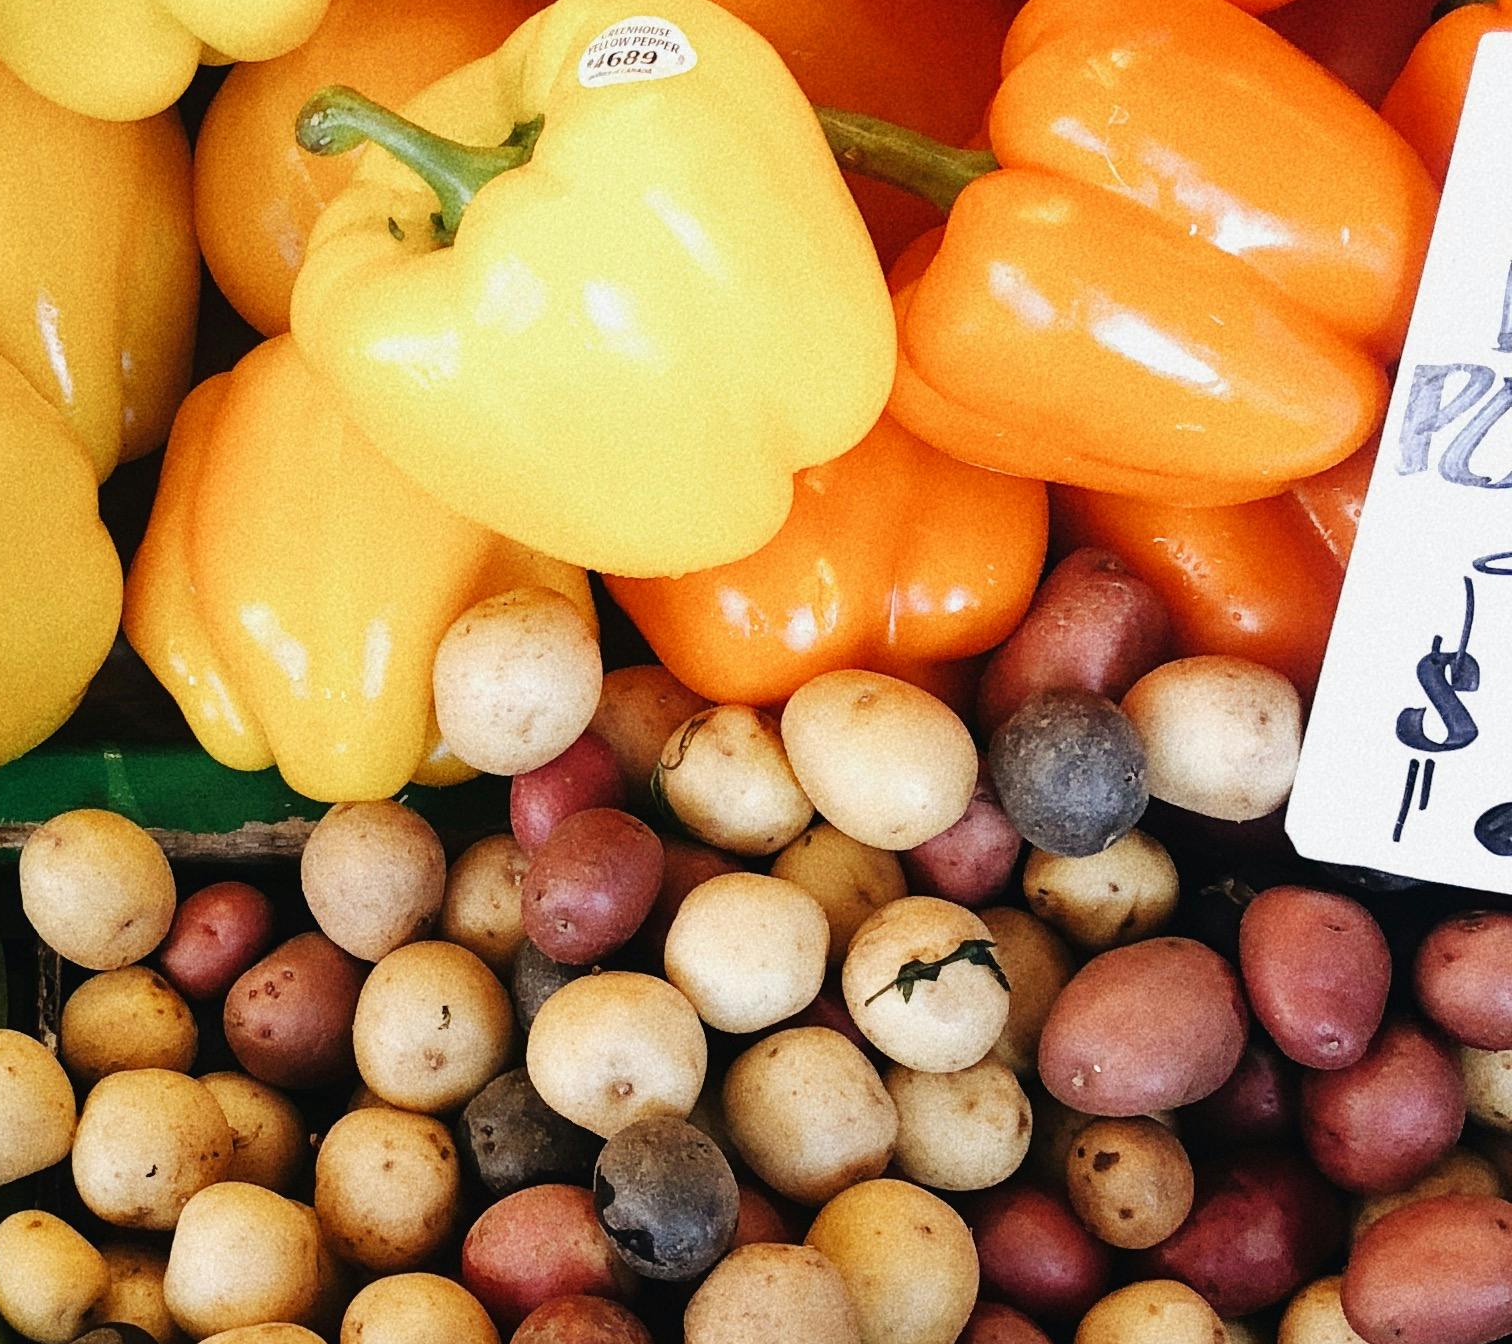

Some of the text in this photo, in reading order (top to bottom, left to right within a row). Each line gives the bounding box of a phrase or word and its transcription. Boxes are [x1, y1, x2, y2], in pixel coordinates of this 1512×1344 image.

[601, 25, 672, 39] GREENHOUSE
[588, 36, 681, 55] YELLOW PEPPER
[586, 50, 658, 70] #4689
